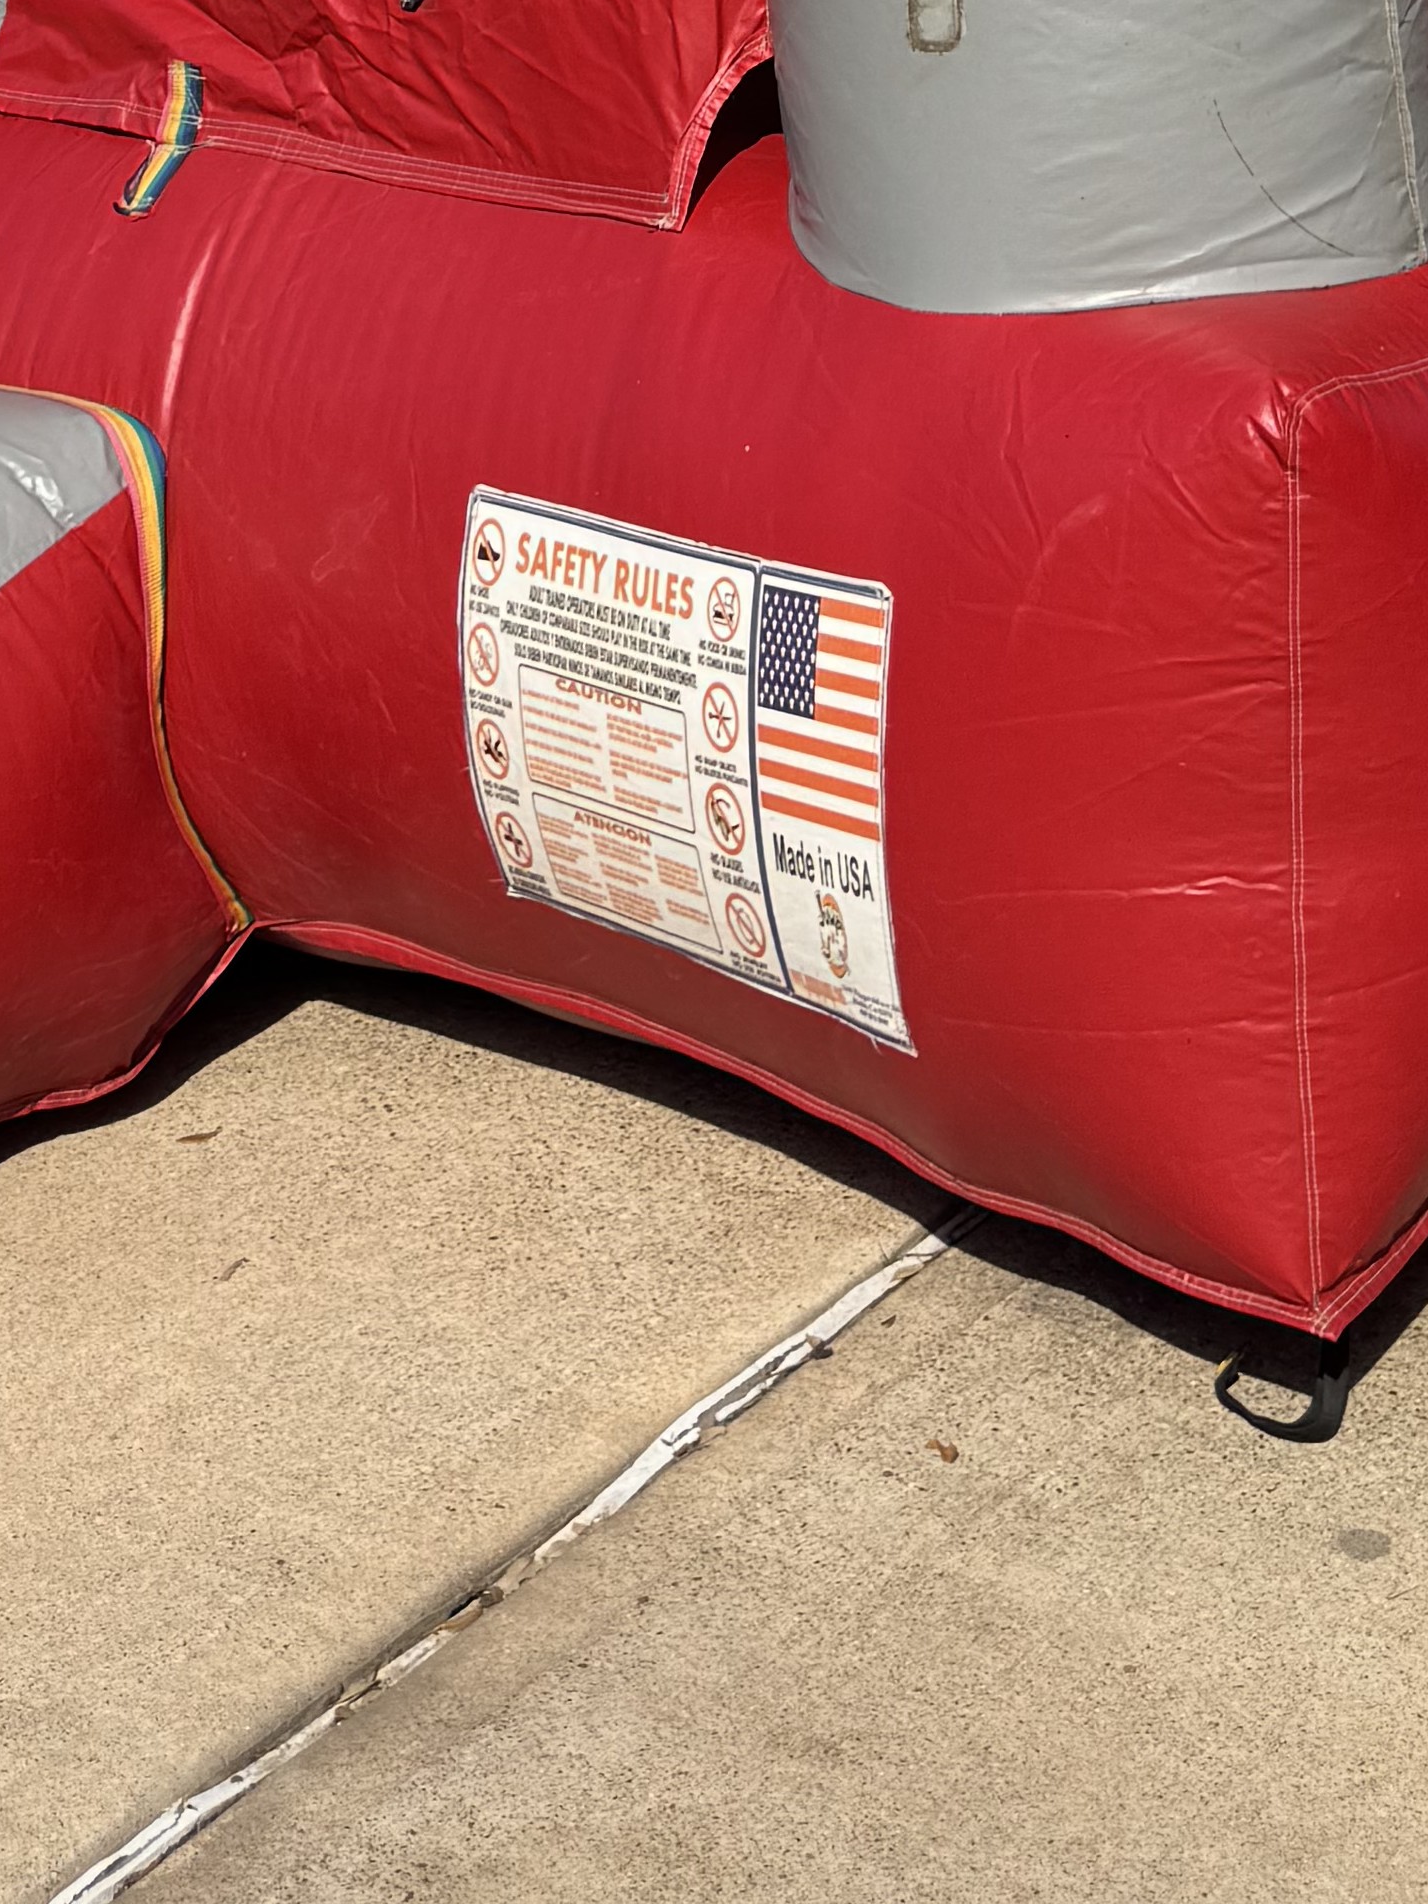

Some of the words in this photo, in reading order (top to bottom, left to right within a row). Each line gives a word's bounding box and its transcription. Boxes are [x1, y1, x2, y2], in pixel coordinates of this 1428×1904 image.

[515, 532, 608, 594] SAFETY
[613, 558, 694, 619] RULES
[555, 678, 642, 715] CAUTION
[773, 833, 815, 883] Made
[817, 846, 835, 889] in
[837, 851, 875, 902] USA
